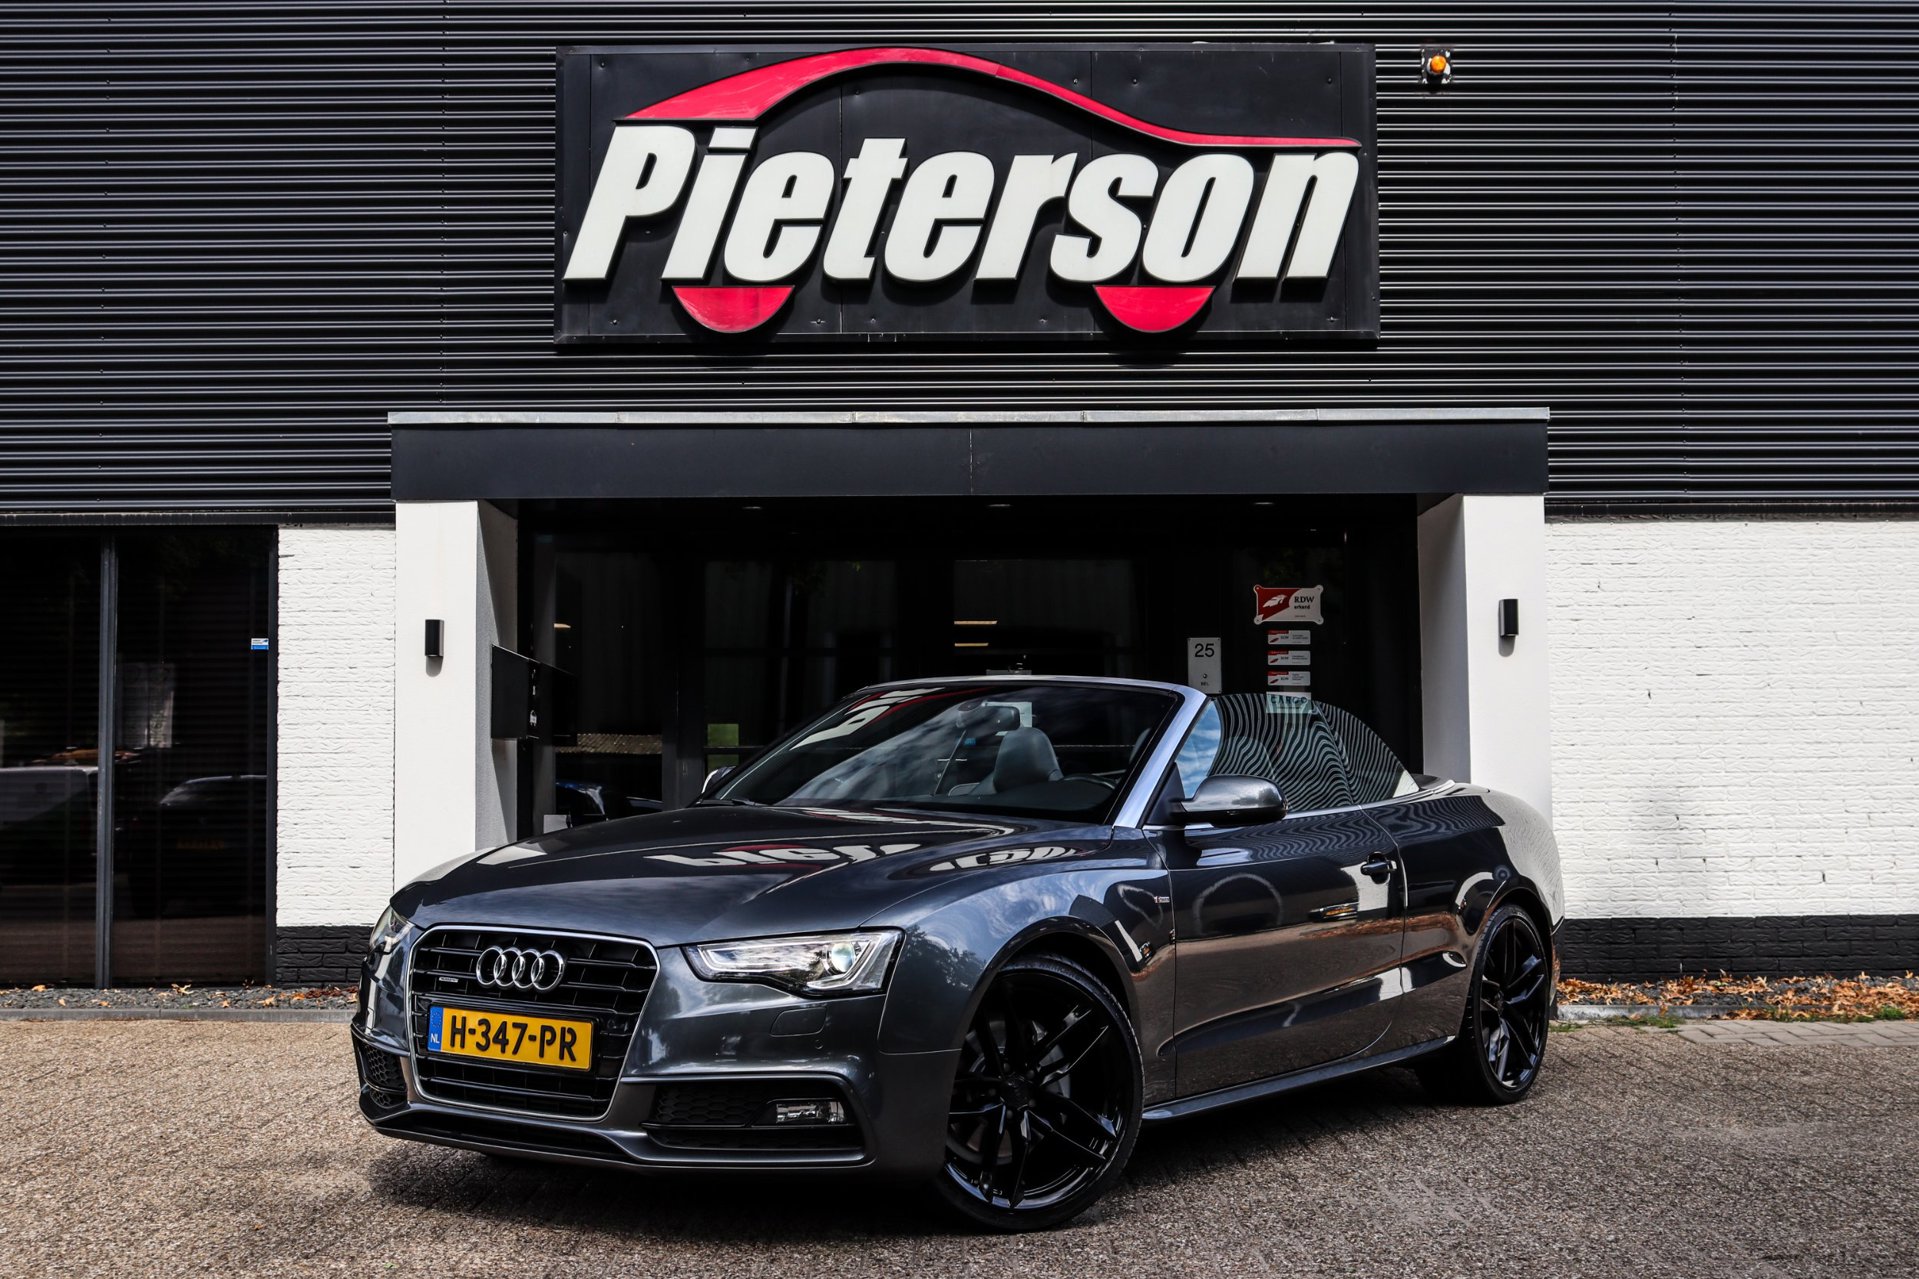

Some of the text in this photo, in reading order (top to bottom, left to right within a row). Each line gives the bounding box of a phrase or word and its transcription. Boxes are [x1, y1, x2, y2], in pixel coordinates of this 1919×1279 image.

[564, 124, 1360, 284] Pieterson
[1195, 643, 1214, 657] 25
[430, 1033, 440, 1044] NL
[449, 1015, 577, 1062] H-347-PR
